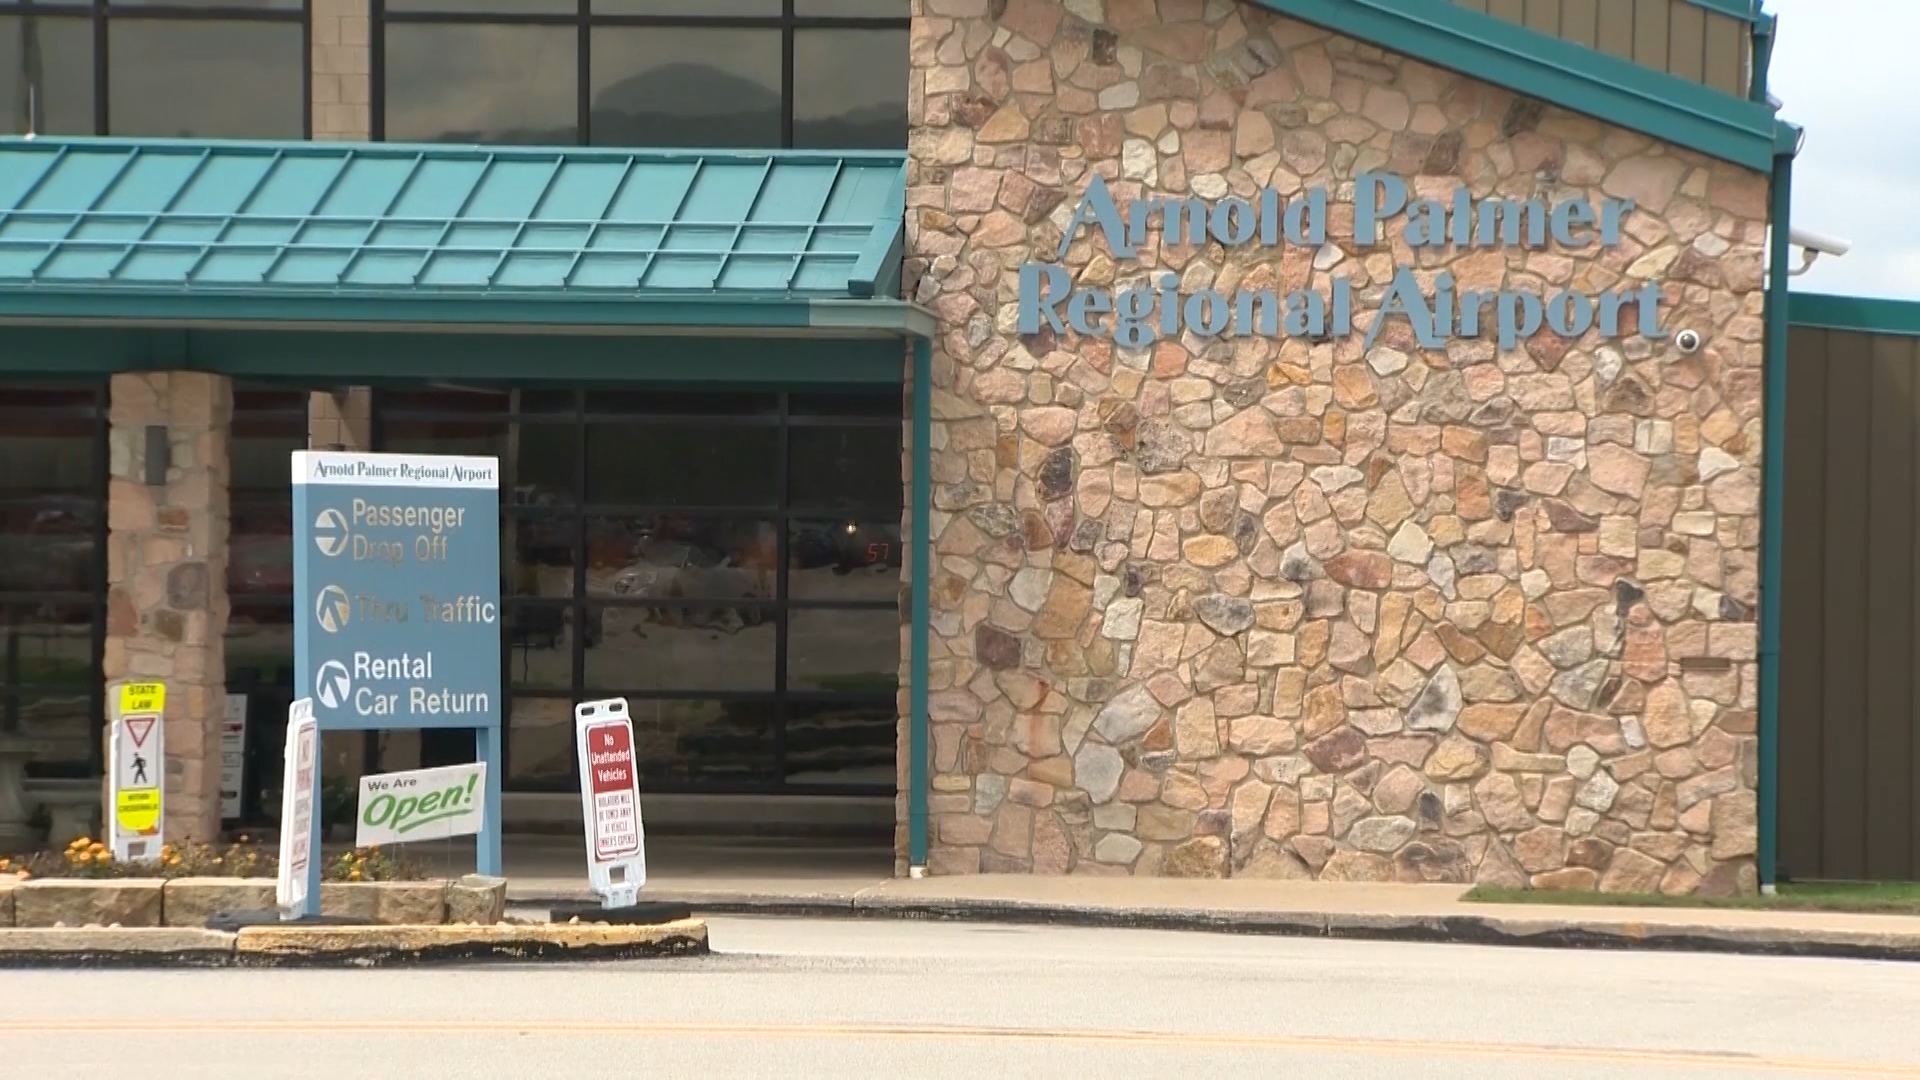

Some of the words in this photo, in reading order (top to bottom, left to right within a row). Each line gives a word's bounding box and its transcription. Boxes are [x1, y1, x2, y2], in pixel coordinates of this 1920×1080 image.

[1056, 172, 1327, 259] Arnold
[1354, 171, 1635, 248] Palmer
[1018, 263, 1351, 349] Regional
[1364, 263, 1670, 350] Airport
[314, 460, 355, 478] Arnold
[357, 461, 397, 478] Palmer
[400, 463, 449, 481] Regional
[450, 464, 493, 482] Airport
[353, 498, 466, 534] Passenger
[353, 535, 404, 567] Drop
[415, 535, 449, 562] Off
[355, 594, 409, 624] Thru
[420, 593, 496, 624] Traffic
[354, 651, 433, 680] Rental
[128, 685, 157, 696] STATE
[131, 699, 153, 710] LAW
[355, 688, 398, 716] Car
[410, 686, 489, 714] Return
[603, 733, 614, 746] No
[591, 748, 630, 766] Unattended
[367, 780, 389, 792] We
[393, 778, 417, 788] Are
[597, 768, 627, 783] Vehicles
[363, 773, 479, 830] Open!
